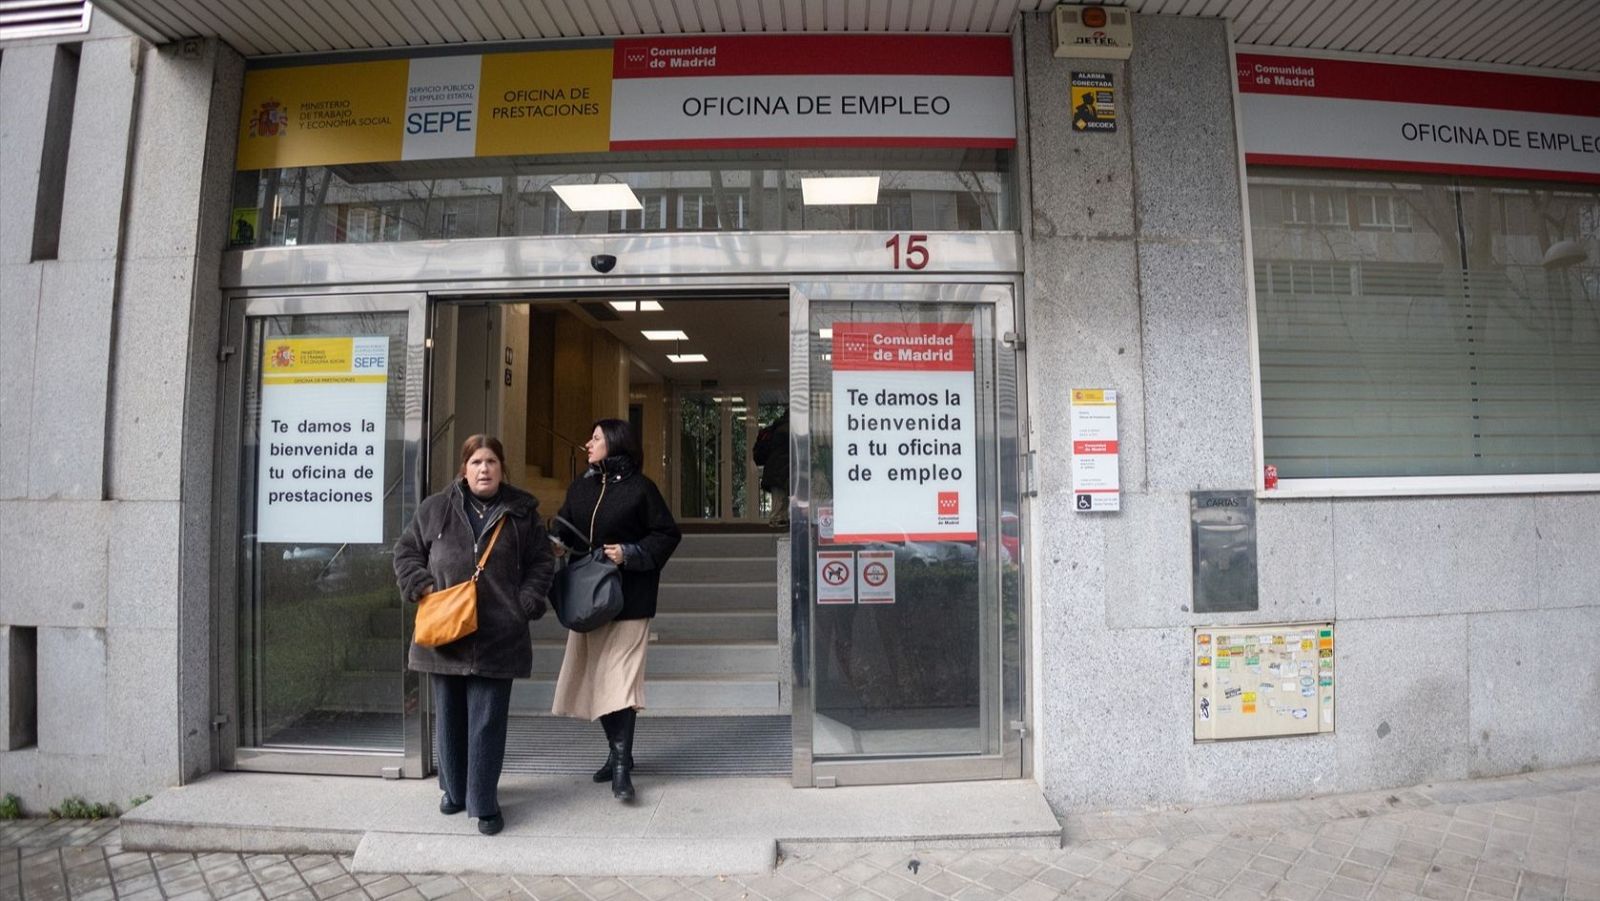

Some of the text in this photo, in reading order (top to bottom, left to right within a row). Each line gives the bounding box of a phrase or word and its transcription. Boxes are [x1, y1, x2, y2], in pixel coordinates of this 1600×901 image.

[650, 45, 717, 57] Comunidad
[649, 56, 717, 68] de Madrid
[1254, 64, 1315, 77] Comunidad
[1072, 79, 1112, 87] CONECTADA
[1255, 75, 1316, 88] de Madrid
[409, 85, 442, 94] SERVICIO
[503, 87, 590, 102] OFICINA DE
[419, 94, 446, 102] EMPLEO
[447, 92, 473, 100] ESTATAL
[300, 100, 350, 111] MINISTERIO
[492, 103, 600, 119] PRESTACIONES
[682, 96, 951, 117] OFICINA DE EMPLEO
[299, 109, 352, 121] DE TRABAJO
[298, 121, 306, 130] Y
[358, 116, 391, 127] SOCIAL
[406, 110, 472, 135] SEPE
[1401, 122, 1489, 146] OFICINA
[1493, 128, 1521, 148] DE
[885, 233, 930, 270] 15
[872, 334, 954, 346] Comunidad
[872, 348, 954, 362] de Madrid
[354, 357, 385, 368] SEPE
[846, 388, 961, 406] Te damos la
[271, 419, 375, 433] Te damos la
[847, 414, 962, 431] bienvenida
[270, 441, 374, 456] bienvenida a
[847, 439, 962, 456] a tu oficina
[269, 465, 374, 479] tu oficina de
[847, 464, 963, 485] de empleo
[268, 488, 373, 505] prestaciones
[1206, 497, 1240, 507] CARTAS
